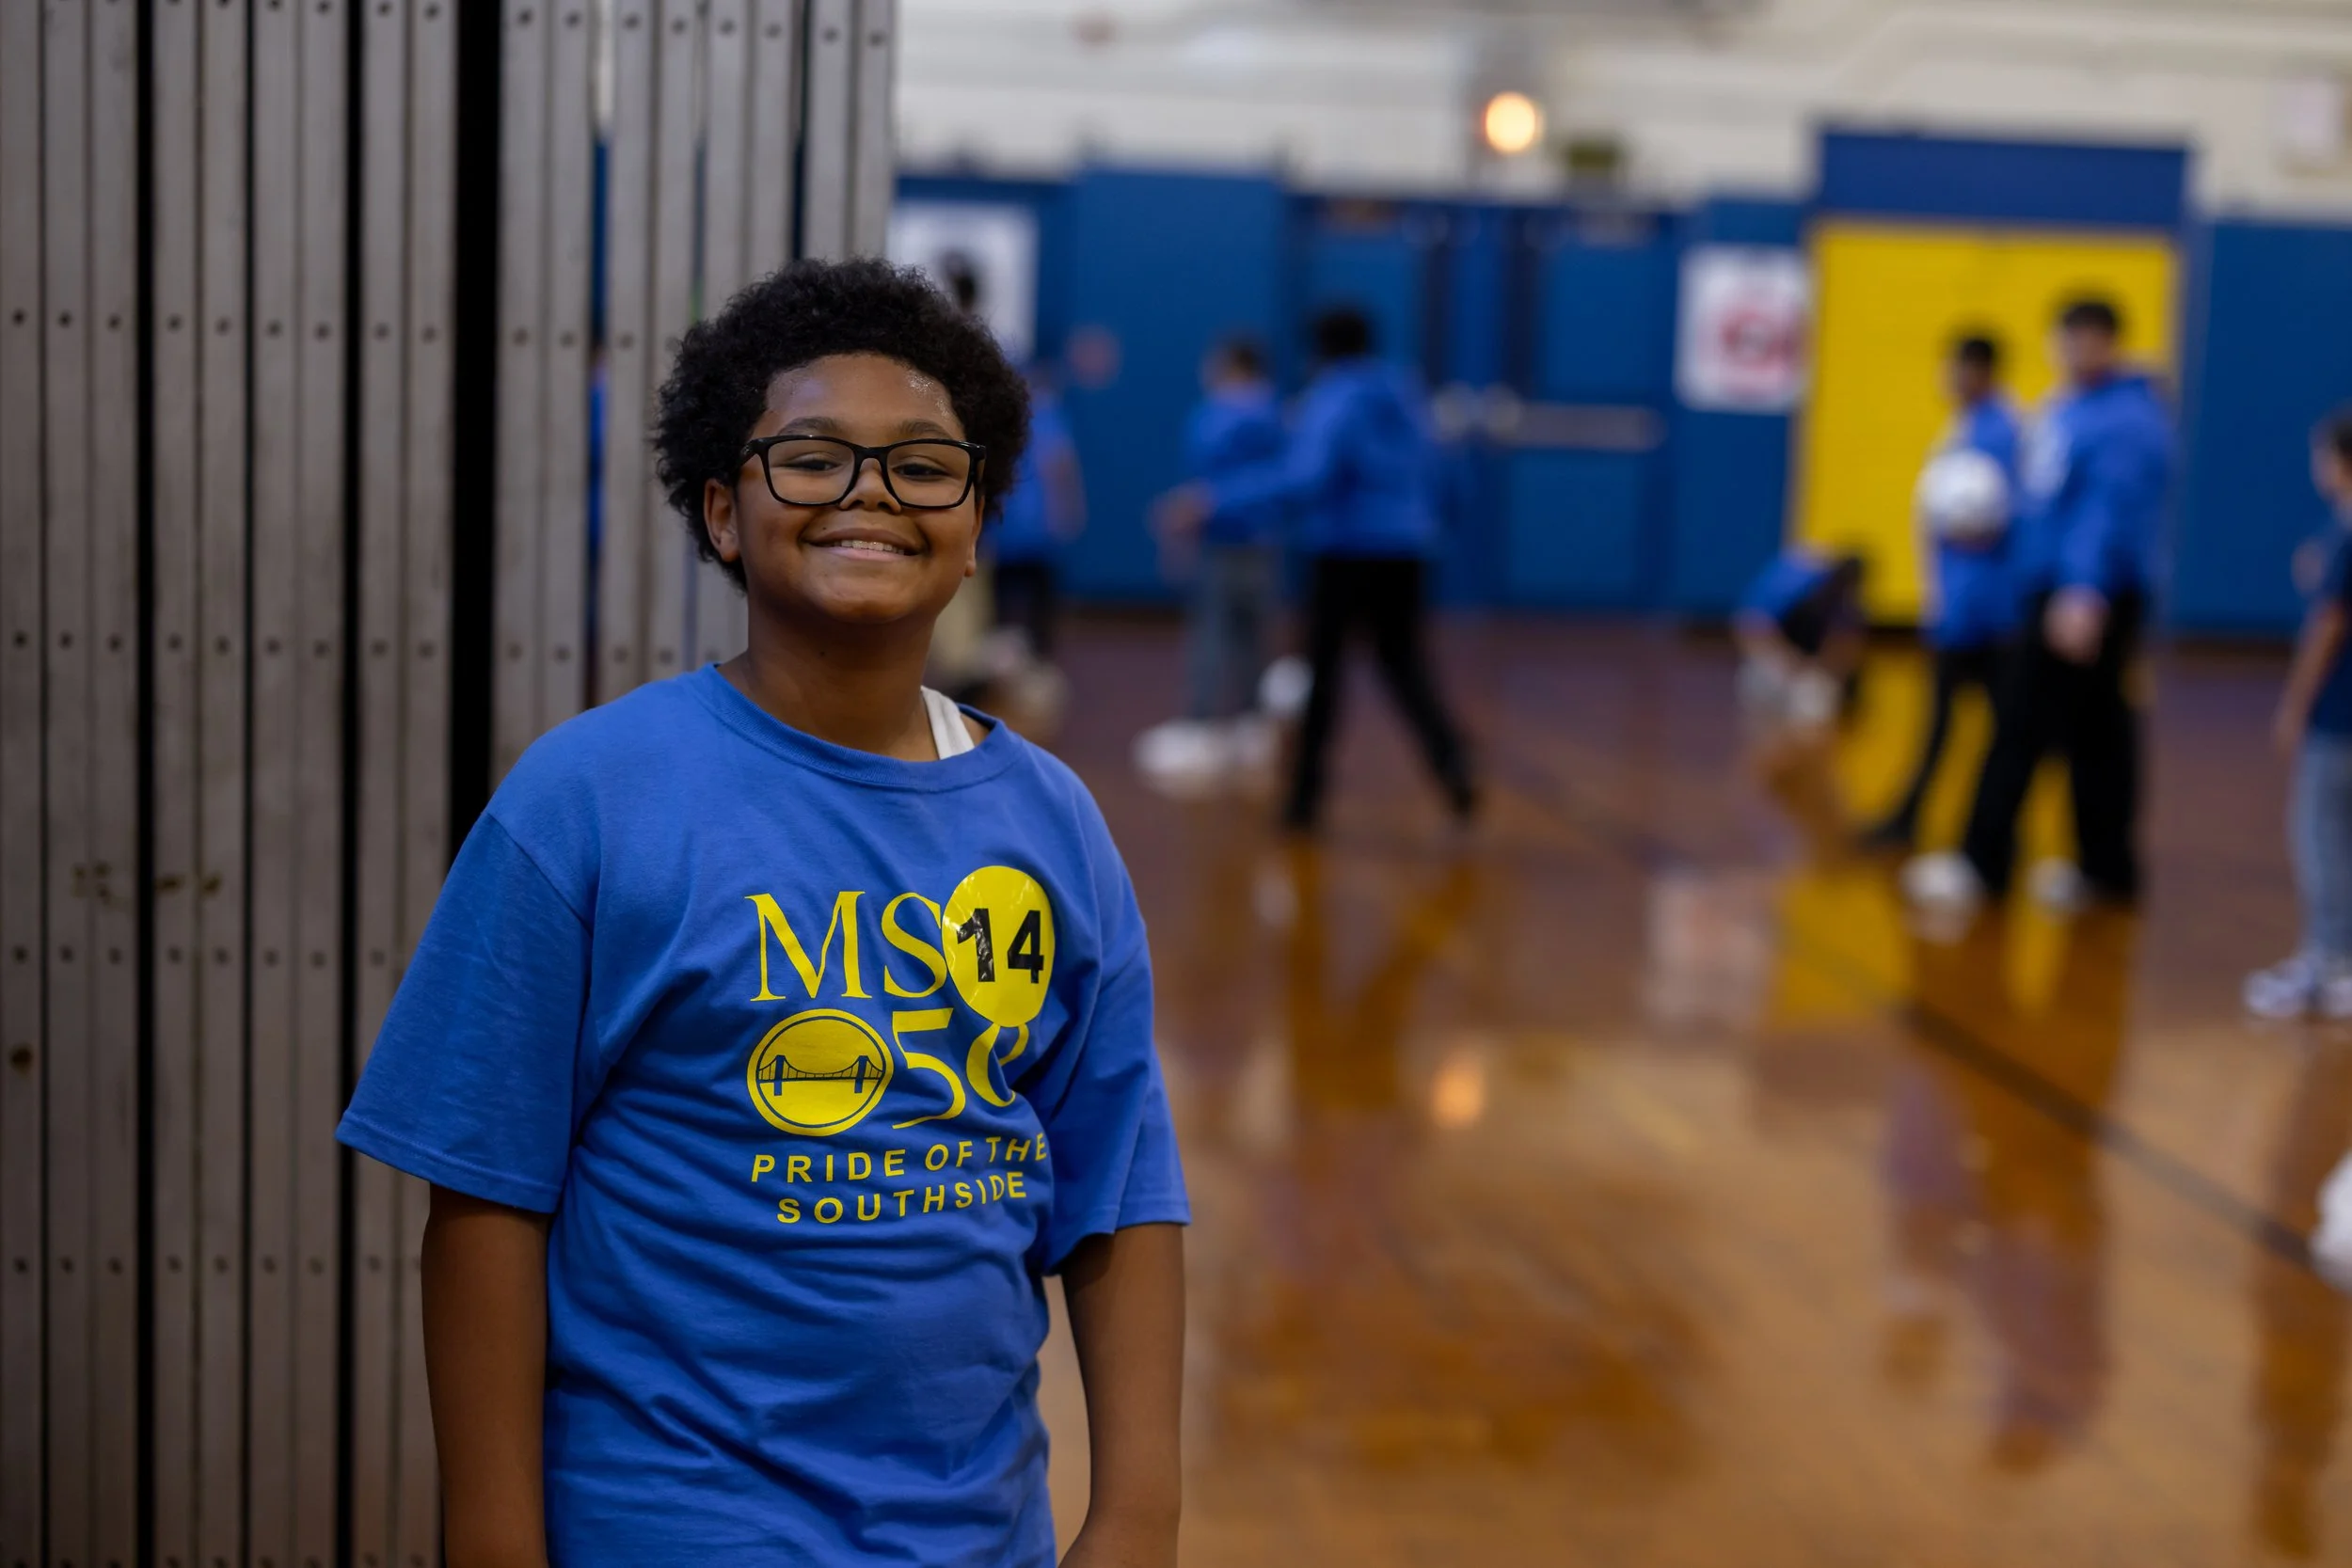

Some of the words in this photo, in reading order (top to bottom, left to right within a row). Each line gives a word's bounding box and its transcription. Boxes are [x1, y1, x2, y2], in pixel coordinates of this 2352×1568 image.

[744, 890, 947, 1002] MS
[956, 907, 1045, 985] 14
[751, 1148, 907, 1183] PRIDE
[924, 1140, 975, 1172] OF
[985, 1132, 1048, 1164] THE
[776, 1171, 1027, 1224] SOUTHSIDE
